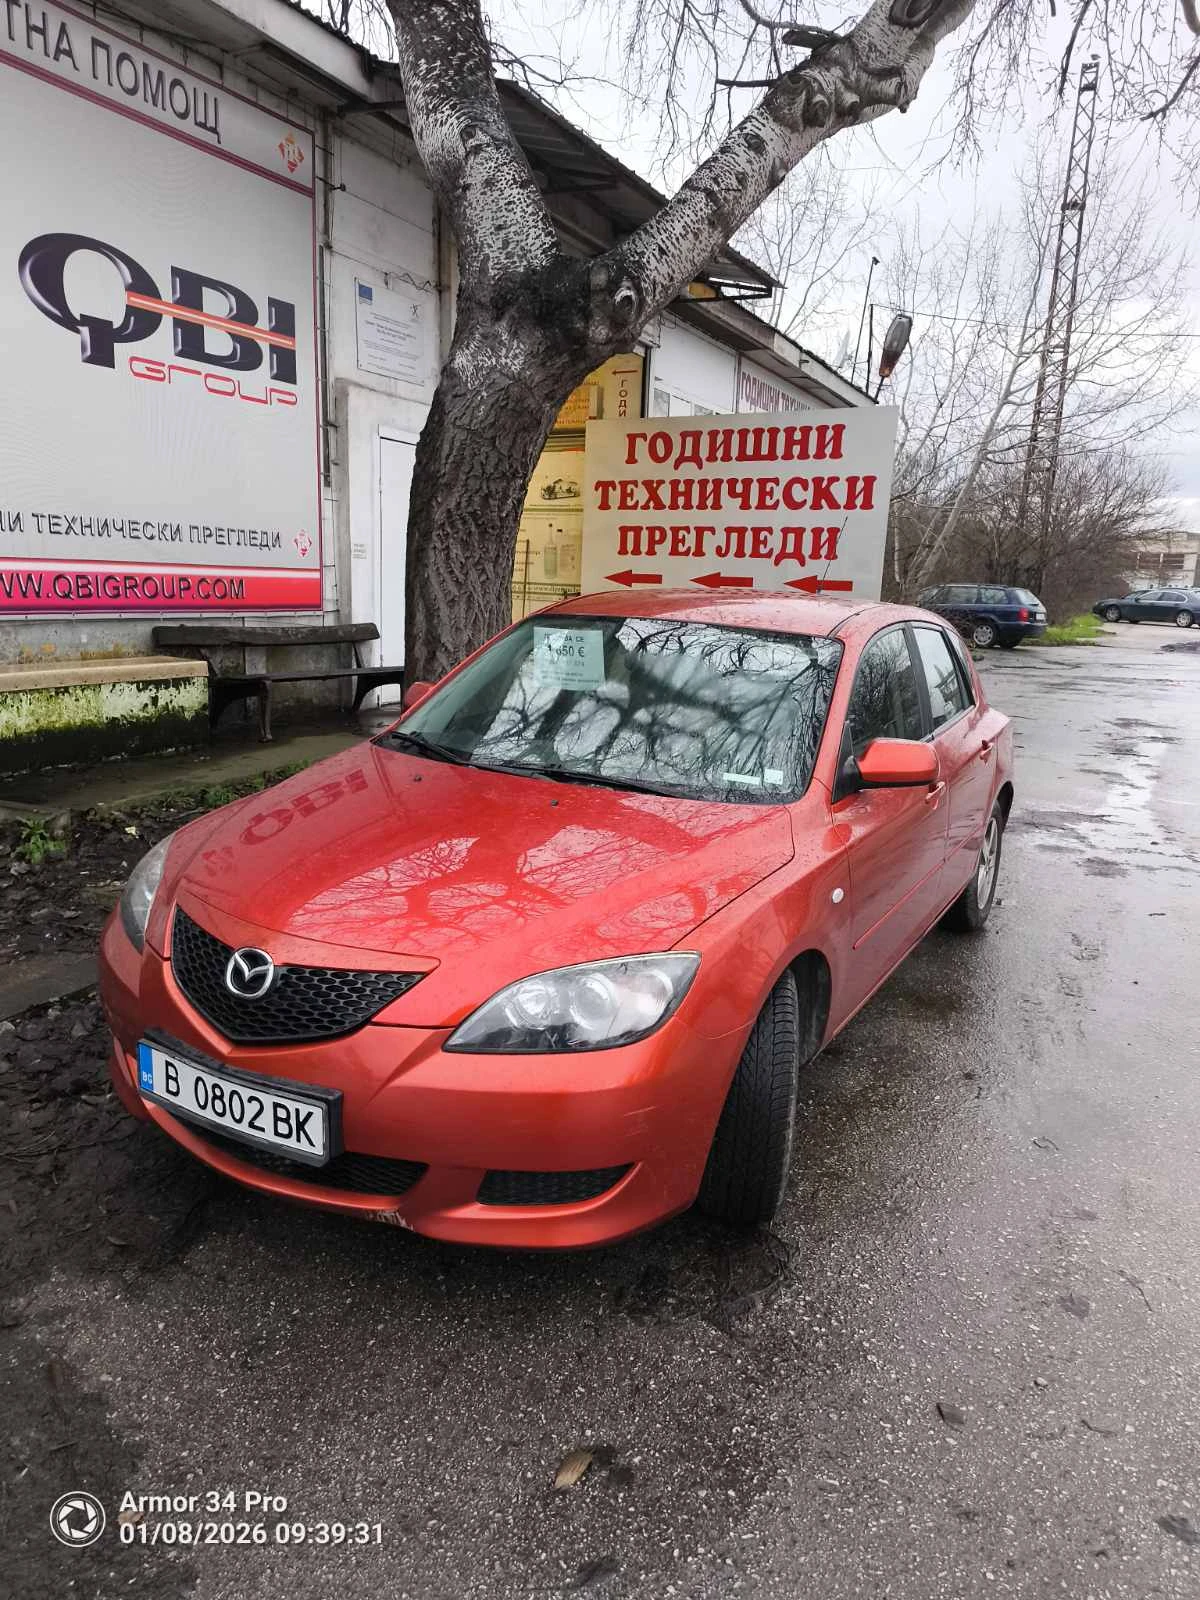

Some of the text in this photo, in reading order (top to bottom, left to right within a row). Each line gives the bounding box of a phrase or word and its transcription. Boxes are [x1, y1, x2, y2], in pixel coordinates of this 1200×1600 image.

[91, 36, 221, 144] ПОМОЩ
[18, 232, 298, 385] QBI
[625, 423, 846, 470] ГОДИШНИ
[594, 475, 877, 511] ТЕХНИЧЕСКИ
[32, 512, 183, 543] ТЕХНИЧЕСКИ
[189, 524, 281, 551] ПРЕГЛЕДИ
[617, 525, 841, 567] ПРЕГЛЕДИ
[142, 1071, 153, 1084] BG
[165, 1060, 180, 1097] B
